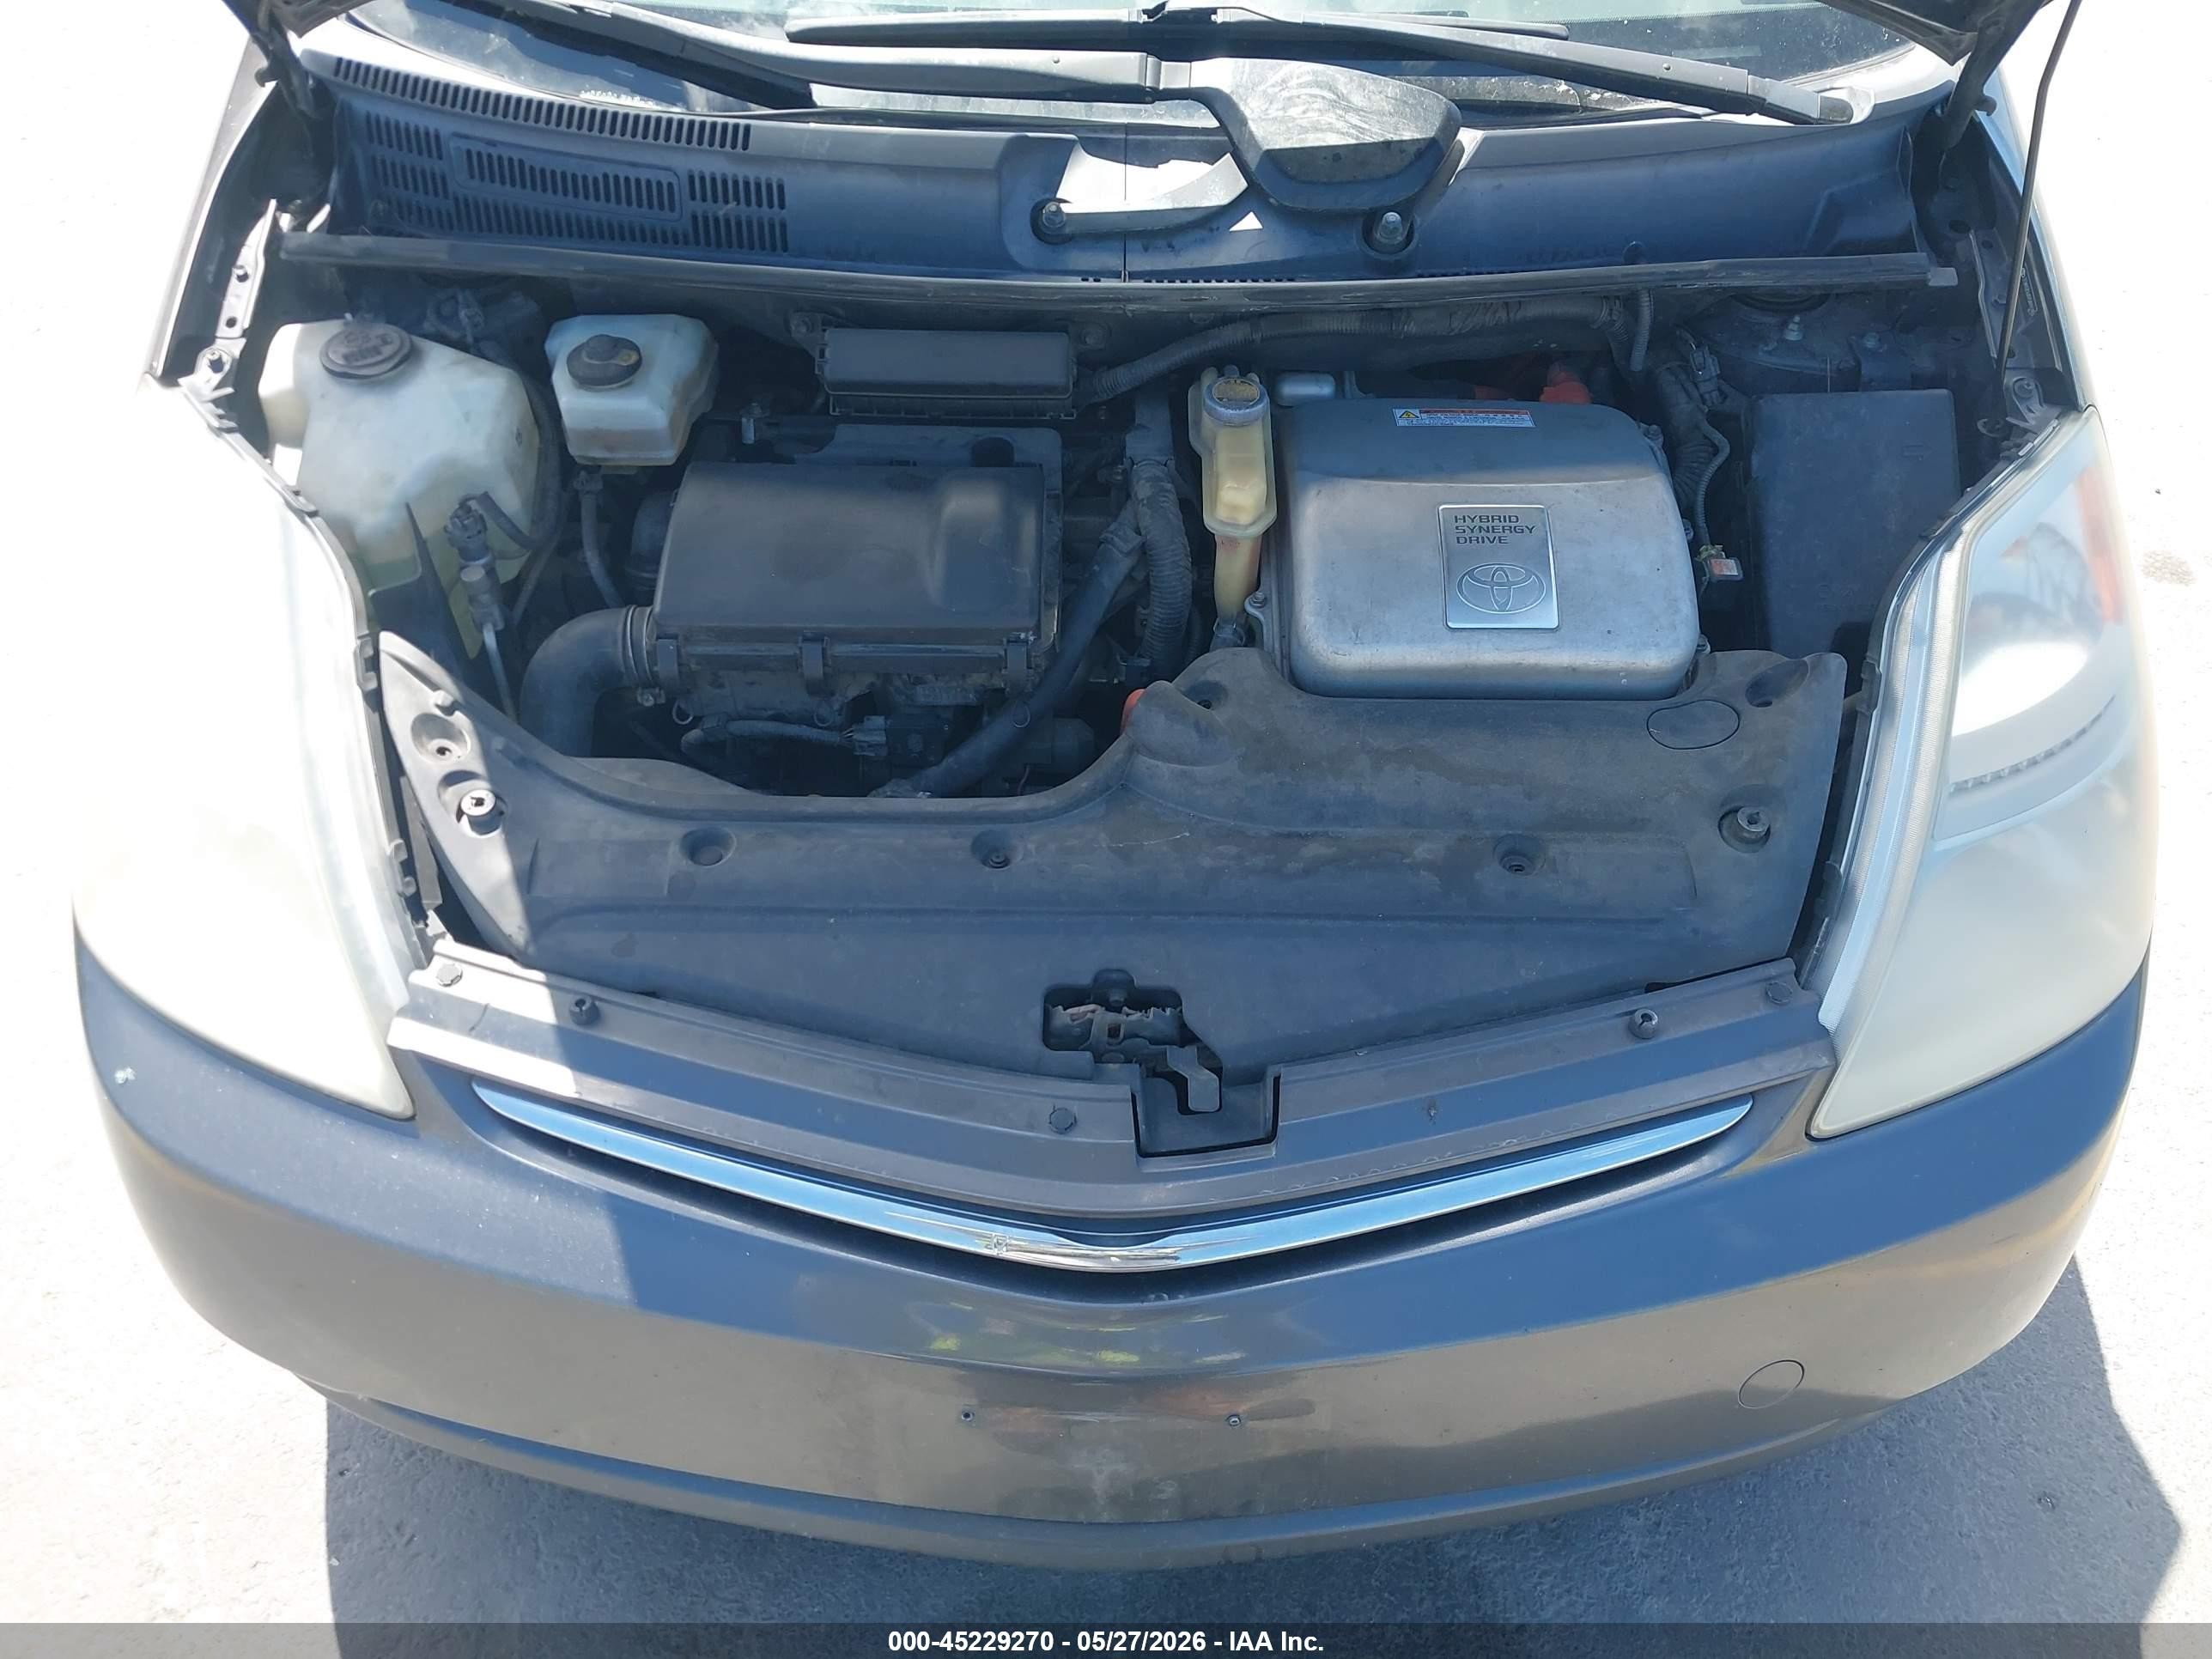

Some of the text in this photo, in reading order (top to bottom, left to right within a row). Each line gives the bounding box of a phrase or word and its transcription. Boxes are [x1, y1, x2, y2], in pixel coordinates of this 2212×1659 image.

[1455, 515, 1519, 524] HYBRID
[1455, 526, 1536, 534] SYNERGY
[1456, 536, 1509, 544] DRIVE
